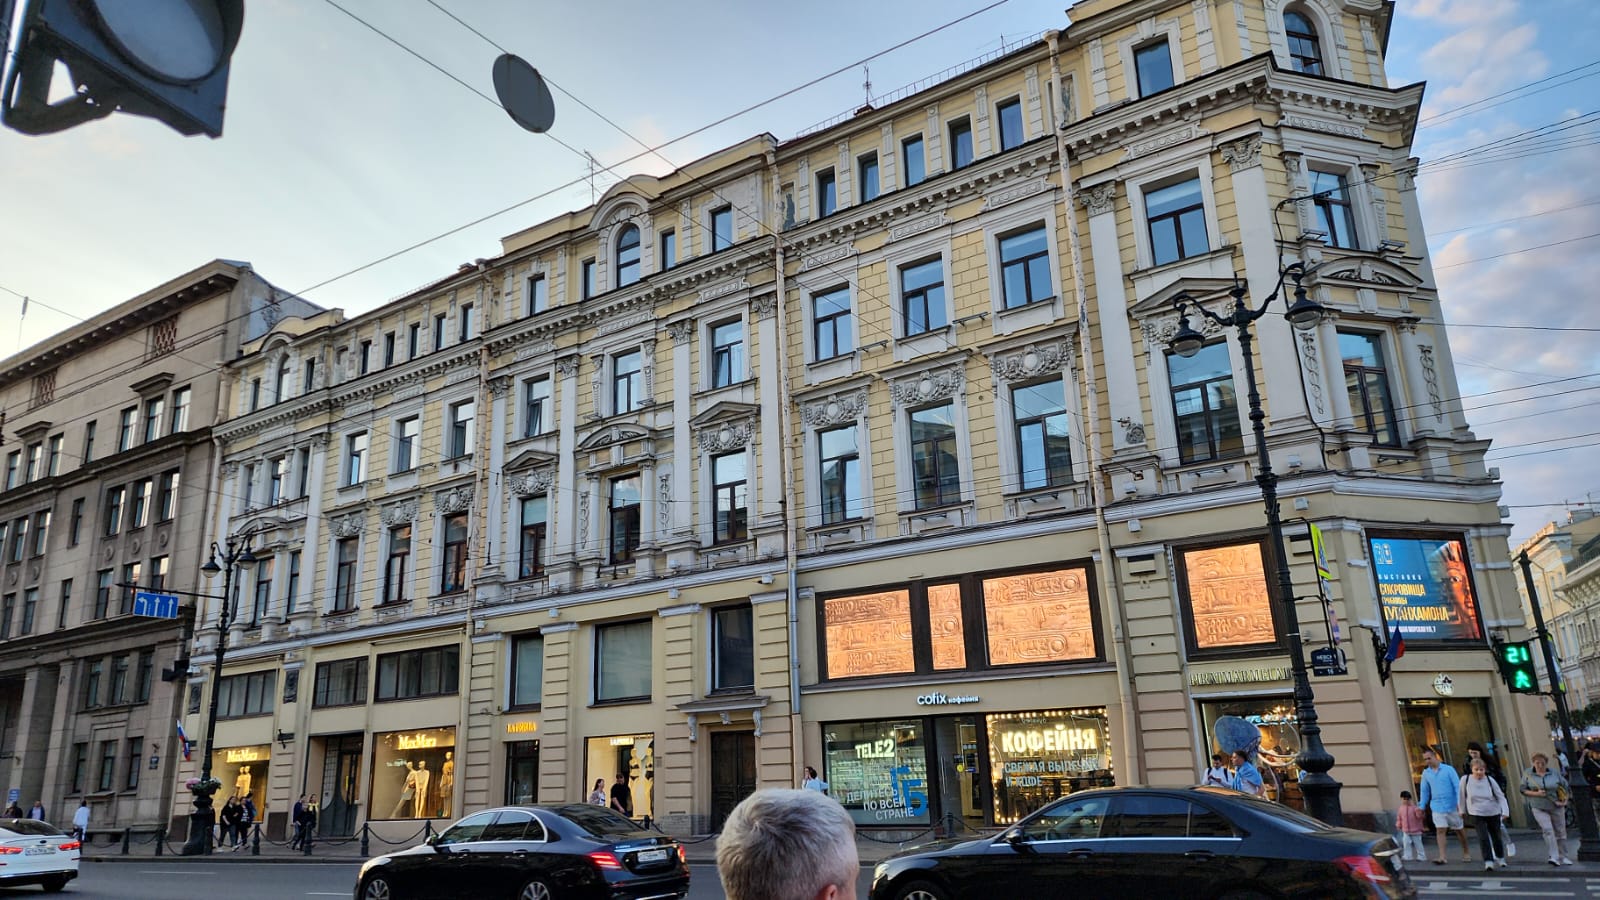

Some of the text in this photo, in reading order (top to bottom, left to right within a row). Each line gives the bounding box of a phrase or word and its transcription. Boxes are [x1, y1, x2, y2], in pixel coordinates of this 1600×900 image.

[1379, 583, 1426, 597] СОКРОВИЩА
[1383, 605, 1449, 621] ТУТАНХАМОНА
[1507, 646, 1529, 663] 21
[917, 691, 947, 705] cofix
[1001, 723, 1098, 753] КОФЕЙНЯ
[855, 738, 895, 759] TELE2
[1004, 761, 1046, 774] СВЕЖАЯ
[863, 800, 878, 812] ПО
[875, 806, 915, 821] СТРАНЕ
